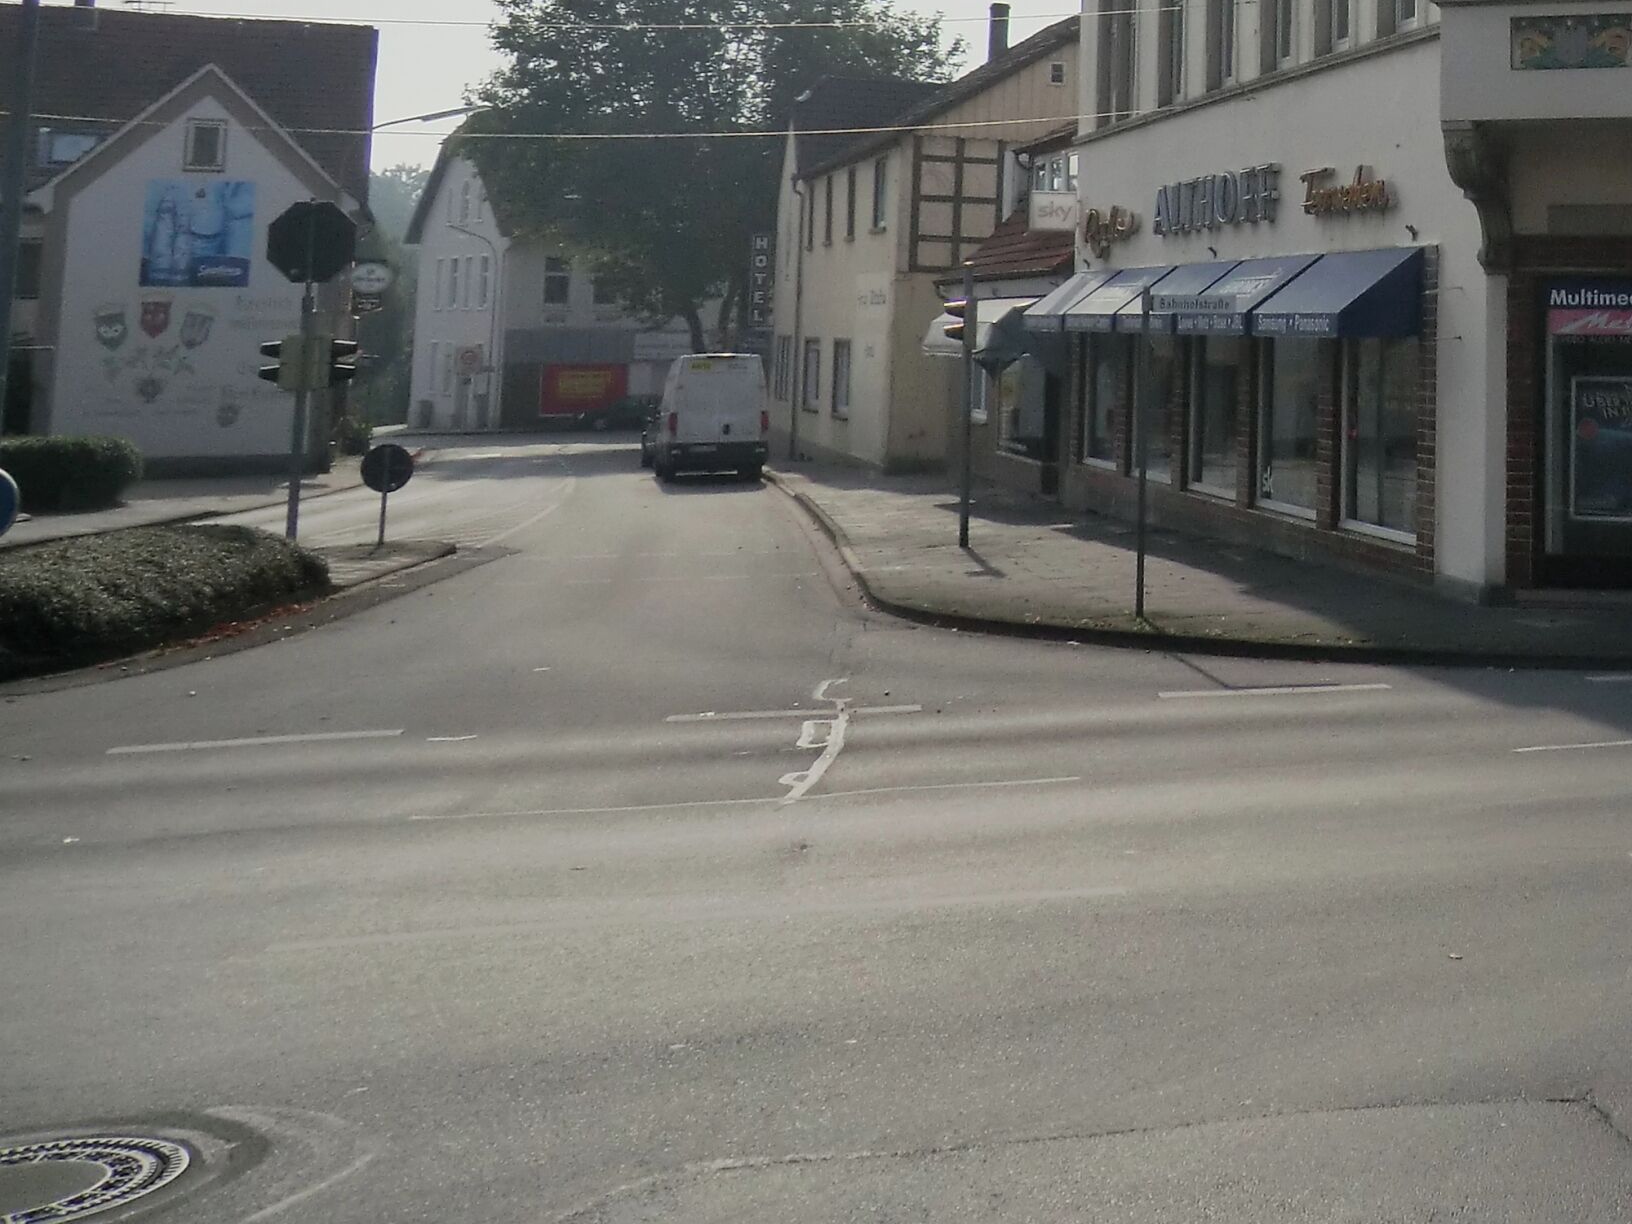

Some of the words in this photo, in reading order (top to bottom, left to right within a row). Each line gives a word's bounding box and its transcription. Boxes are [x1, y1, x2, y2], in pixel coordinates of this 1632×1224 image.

[1153, 162, 1283, 238] ALTHOFF
[1037, 204, 1073, 223] sky
[753, 234, 769, 322] HOTEL
[1159, 297, 1231, 312] Bahnhofstraße
[1257, 313, 1287, 334] Samsung
[1294, 313, 1330, 332] Panasonic
